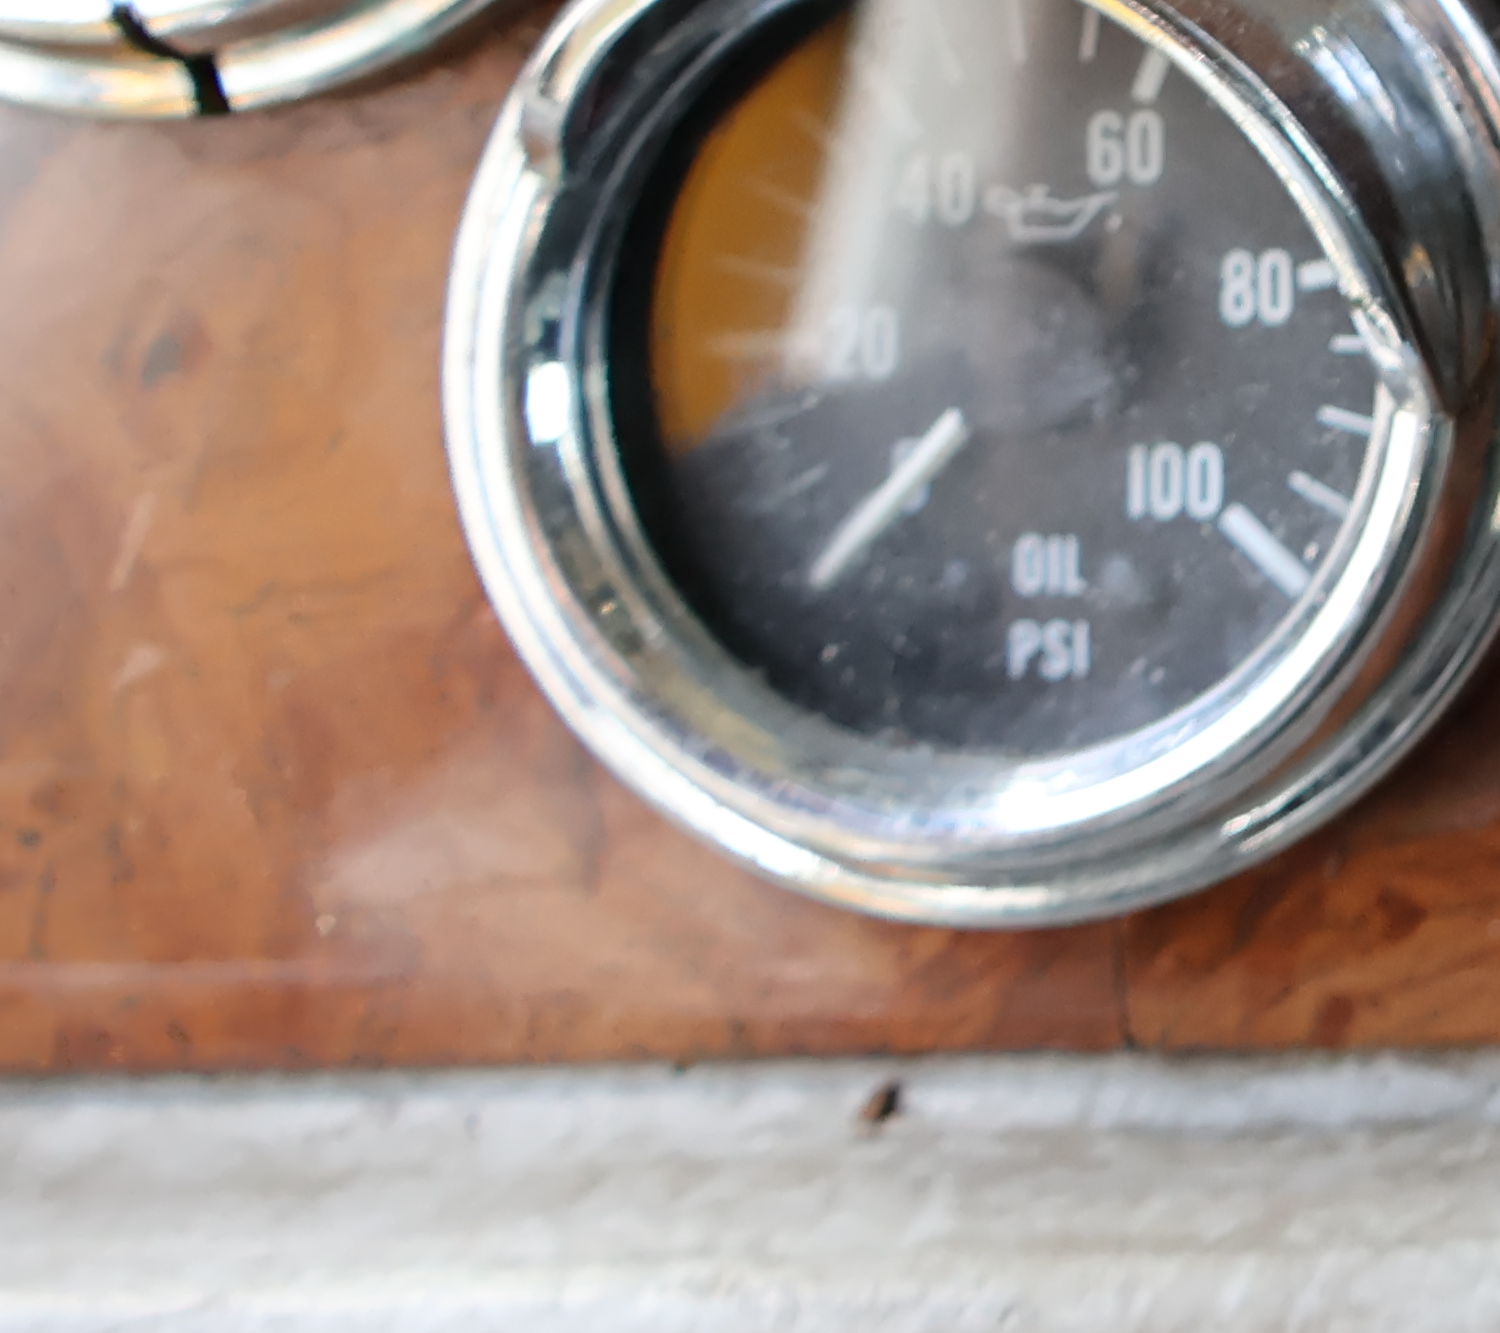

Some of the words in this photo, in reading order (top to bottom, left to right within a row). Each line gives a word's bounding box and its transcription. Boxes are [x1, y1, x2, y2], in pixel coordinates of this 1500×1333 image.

[1086, 110, 1166, 187] 60
[1219, 248, 1294, 326] 80
[1126, 442, 1225, 520] 100
[1012, 536, 1085, 599] OIL
[1007, 620, 1093, 678] PSI
